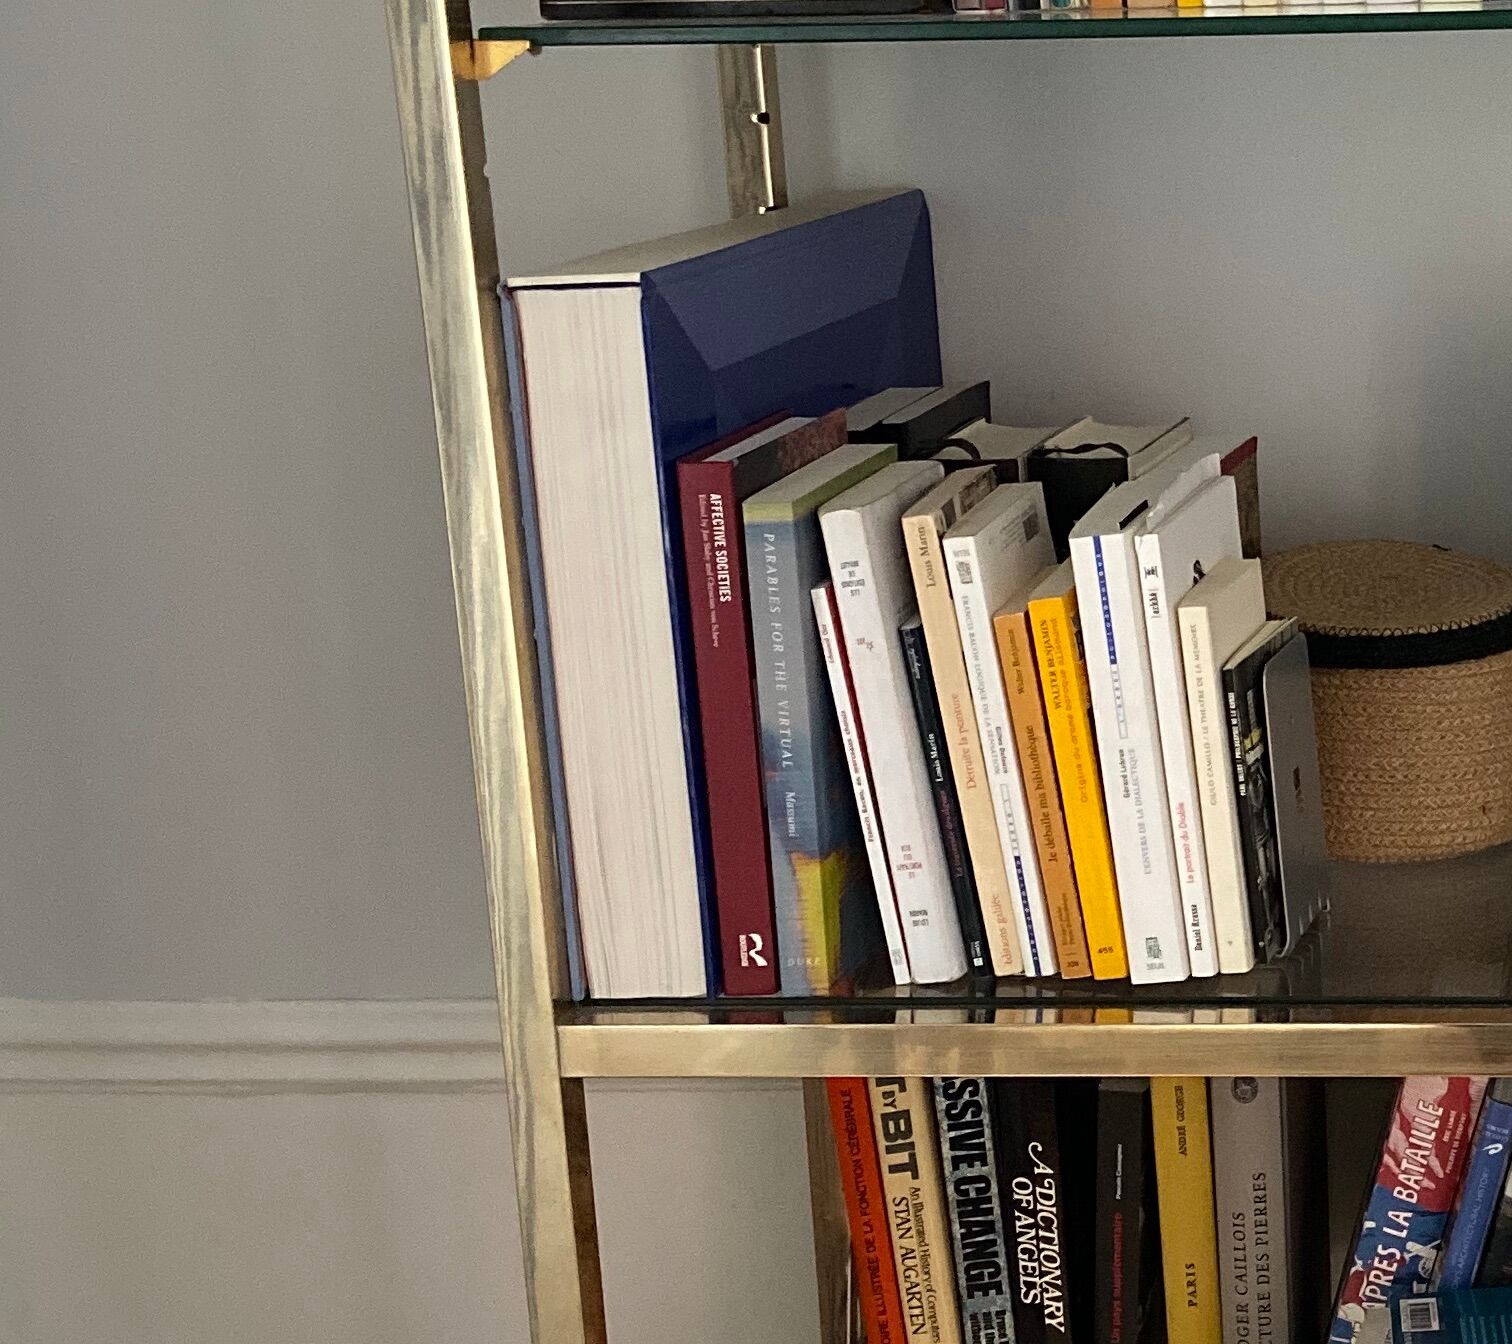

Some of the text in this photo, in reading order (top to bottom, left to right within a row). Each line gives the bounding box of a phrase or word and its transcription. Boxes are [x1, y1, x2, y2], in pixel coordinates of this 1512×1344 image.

[703, 491, 736, 603] AFFECTIVE SOCIETIES
[762, 532, 795, 769] PARABLES FOR THE VIRTUAL
[1390, 1098, 1446, 1205] BATAILLE
[1009, 1176, 1044, 1306] OF ANGELS
[1025, 1140, 1071, 1335] A DICTIONARY
[1253, 1171, 1269, 1245] PIERRES
[1380, 1205, 1414, 1239] LA
[890, 1194, 929, 1336] STAN AUGARTEN
[1184, 1261, 1197, 1307] PARIS
[1231, 1210, 1248, 1295] CAILLOIS
[1256, 1252, 1270, 1285] DES
[981, 1310, 995, 1330] and
[993, 1308, 1010, 1339] Bruce
